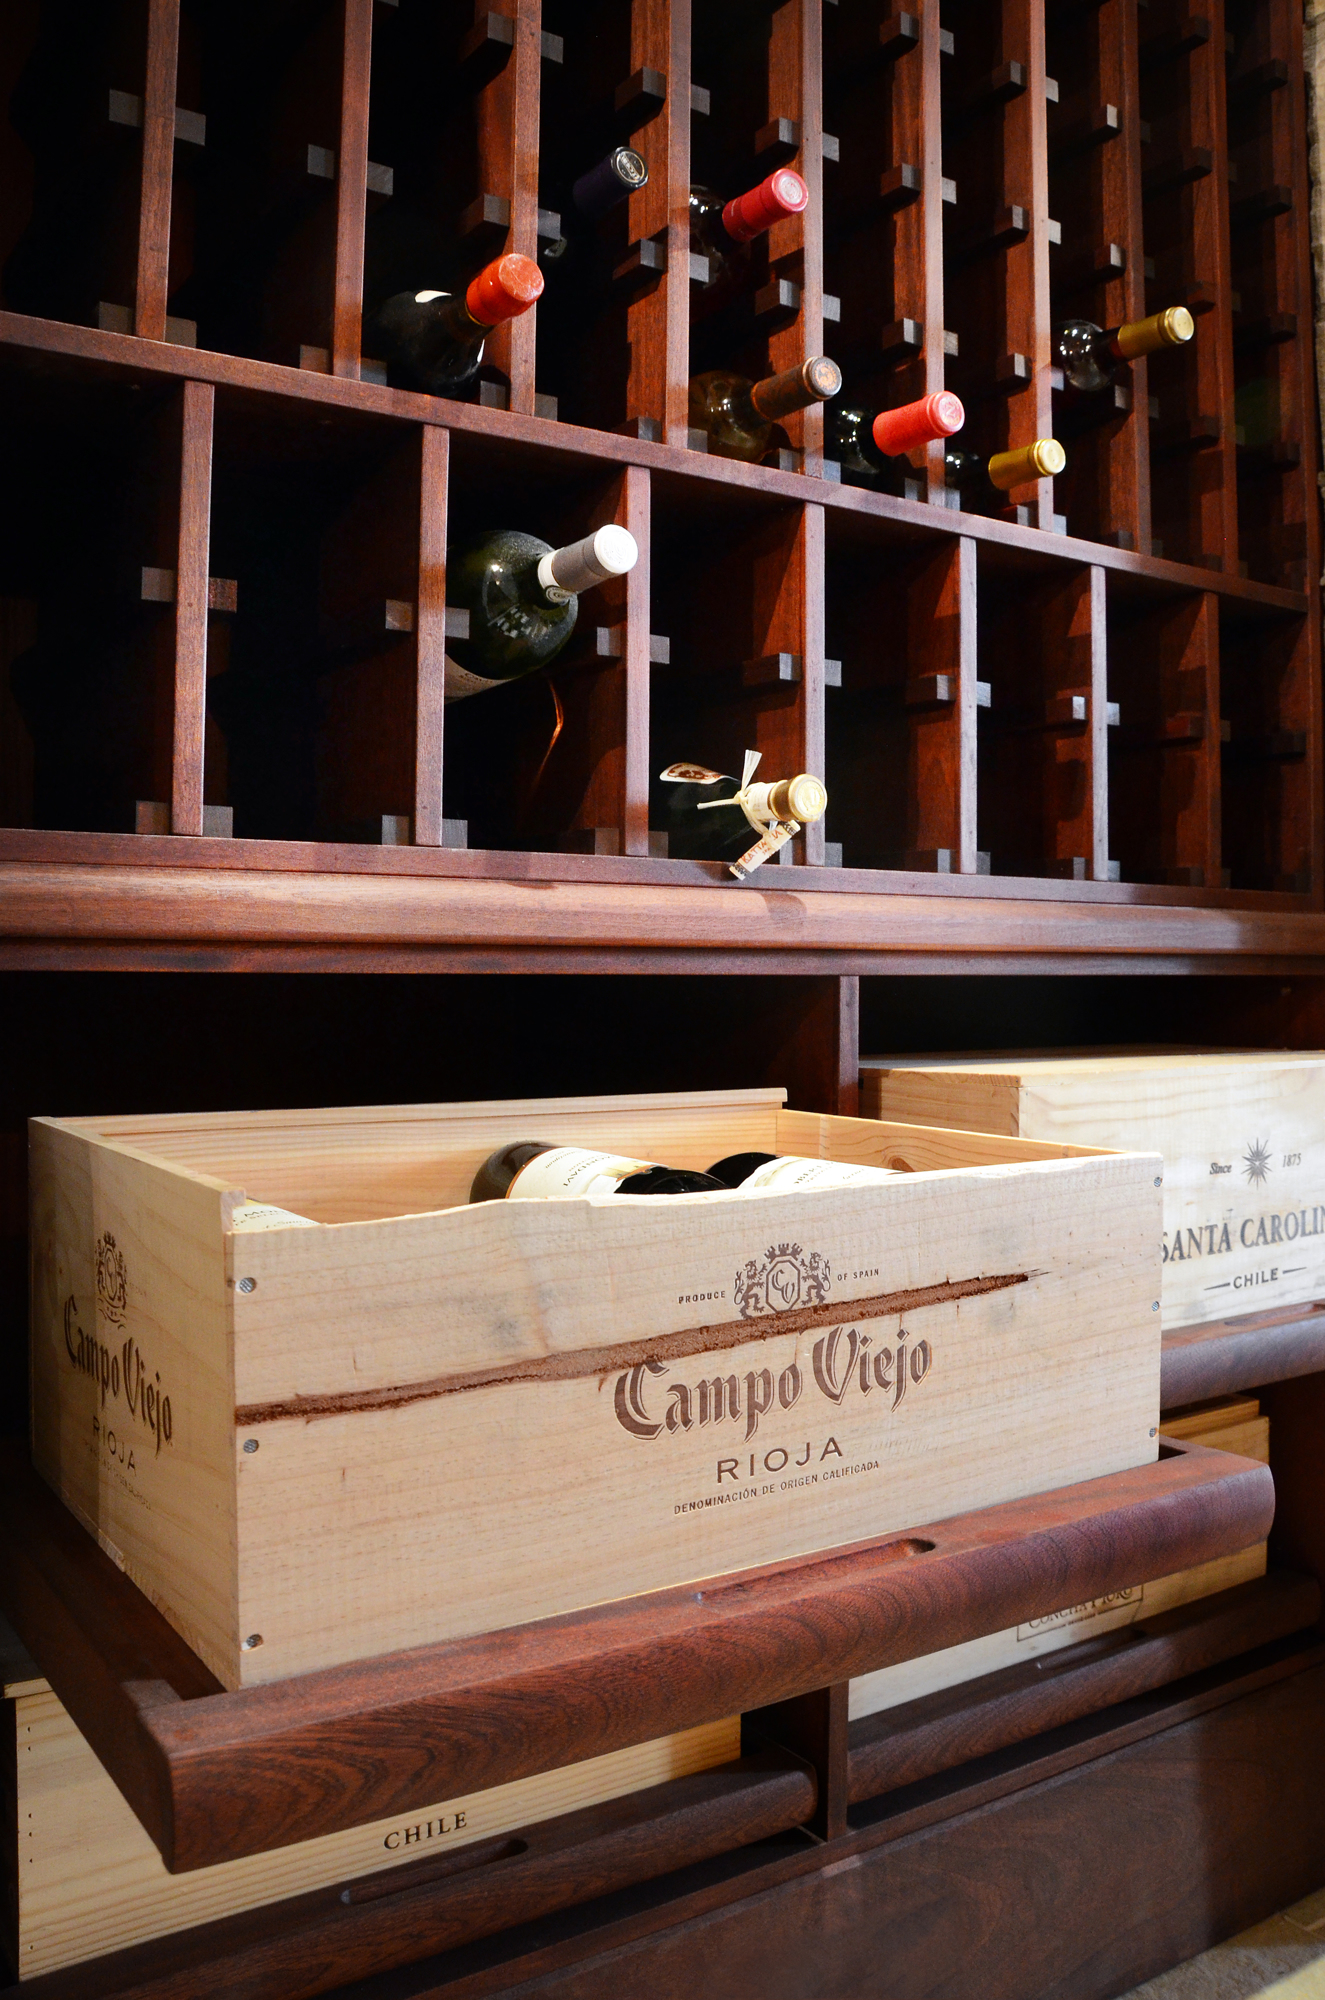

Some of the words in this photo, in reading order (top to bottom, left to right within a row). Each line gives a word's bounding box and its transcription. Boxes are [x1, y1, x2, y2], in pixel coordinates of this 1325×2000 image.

[1209, 1162, 1232, 1175] Since
[1282, 1152, 1302, 1168] 1875
[678, 1289, 726, 1305] PRODUCE
[837, 1272, 848, 1282] OF
[853, 1267, 880, 1280] SPAIN
[1233, 1267, 1279, 1289] CHILE
[64, 1294, 120, 1409] Campo
[122, 1336, 173, 1460] Viejo
[613, 1361, 803, 1443] Campo
[811, 1325, 932, 1413] Viejo
[93, 1415, 137, 1477] RIOJA
[717, 1436, 843, 1484] RIOJA
[673, 1487, 757, 1515] DENOMINACIÓN
[762, 1483, 776, 1496] DE
[780, 1473, 819, 1492] ORIGEN
[822, 1460, 880, 1482] CALIFICADA
[384, 1811, 468, 1850] CHILE
